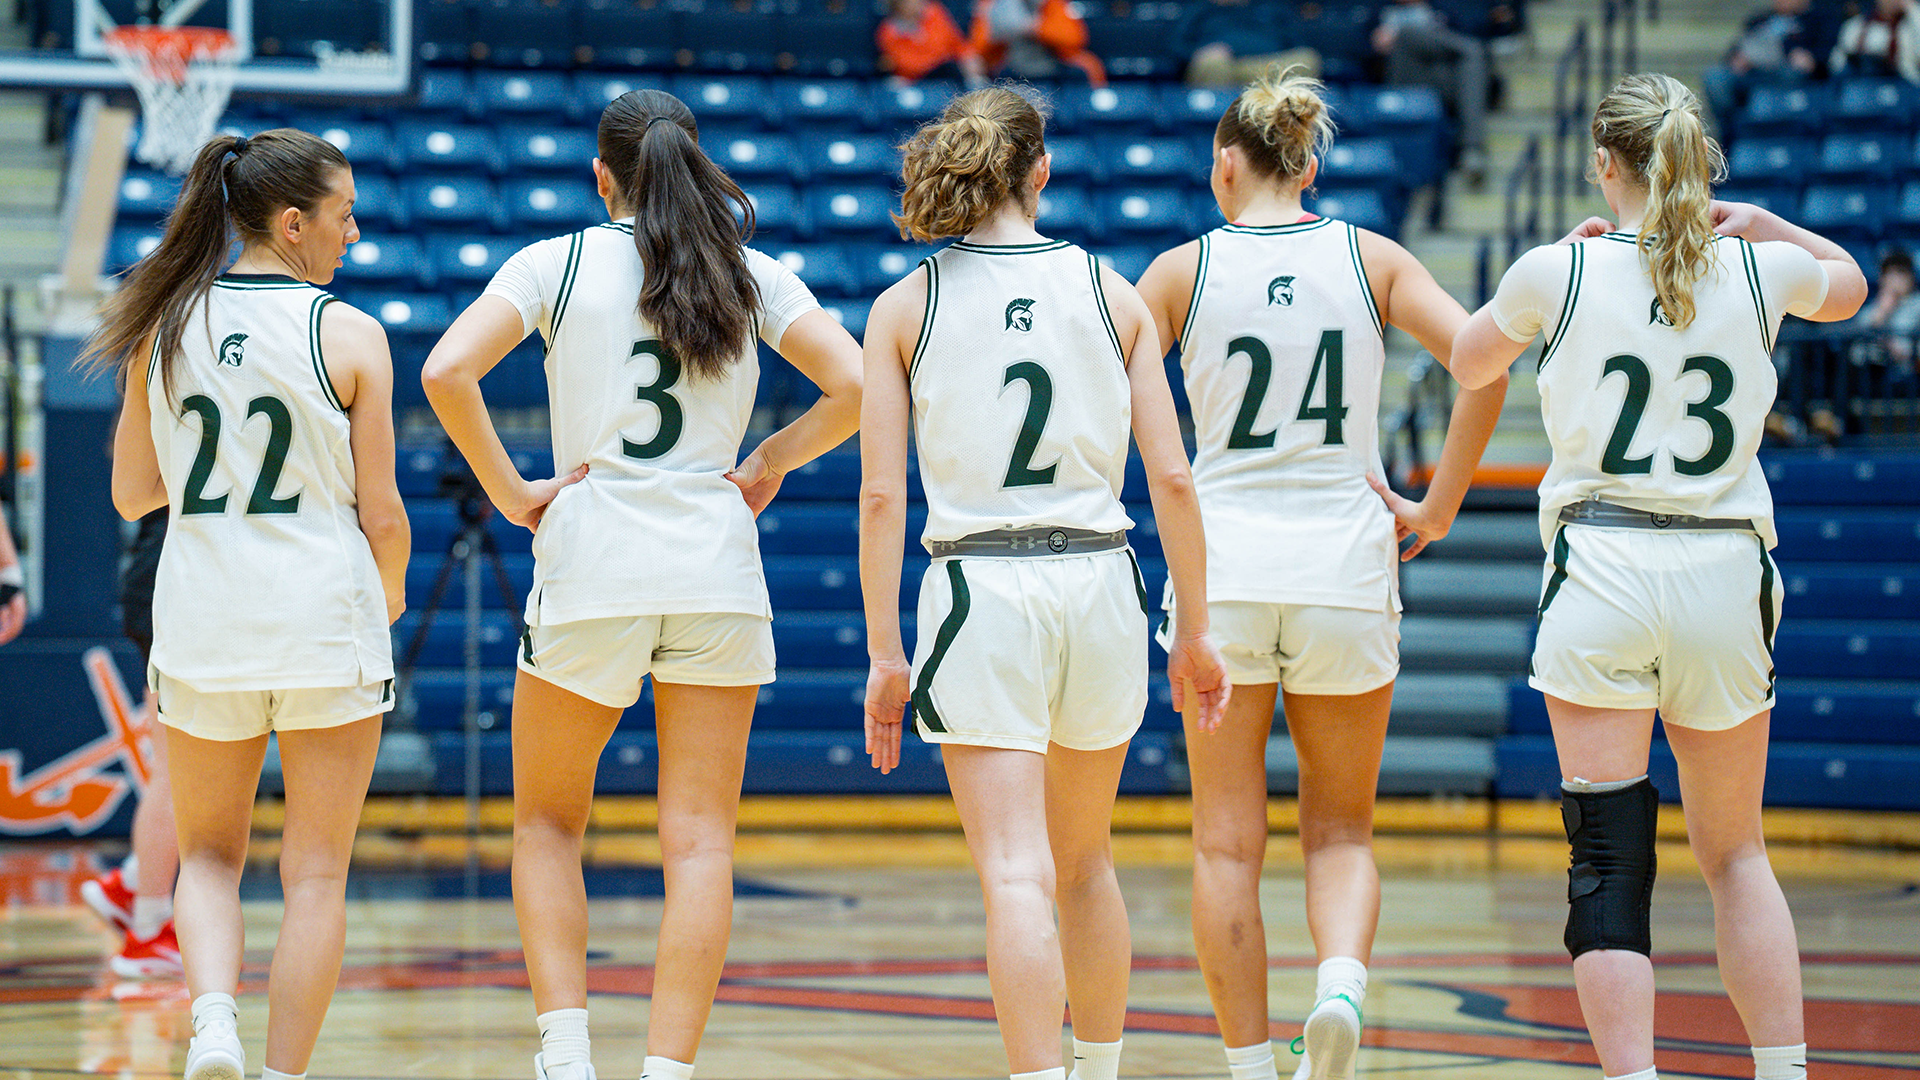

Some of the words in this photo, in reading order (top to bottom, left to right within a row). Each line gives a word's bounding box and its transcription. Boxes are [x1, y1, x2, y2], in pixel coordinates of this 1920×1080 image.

[620, 337, 685, 460] 3
[1001, 361, 1059, 489] 2
[1225, 329, 1350, 452] 24
[1598, 353, 1737, 477] 23
[177, 392, 303, 516] 22
